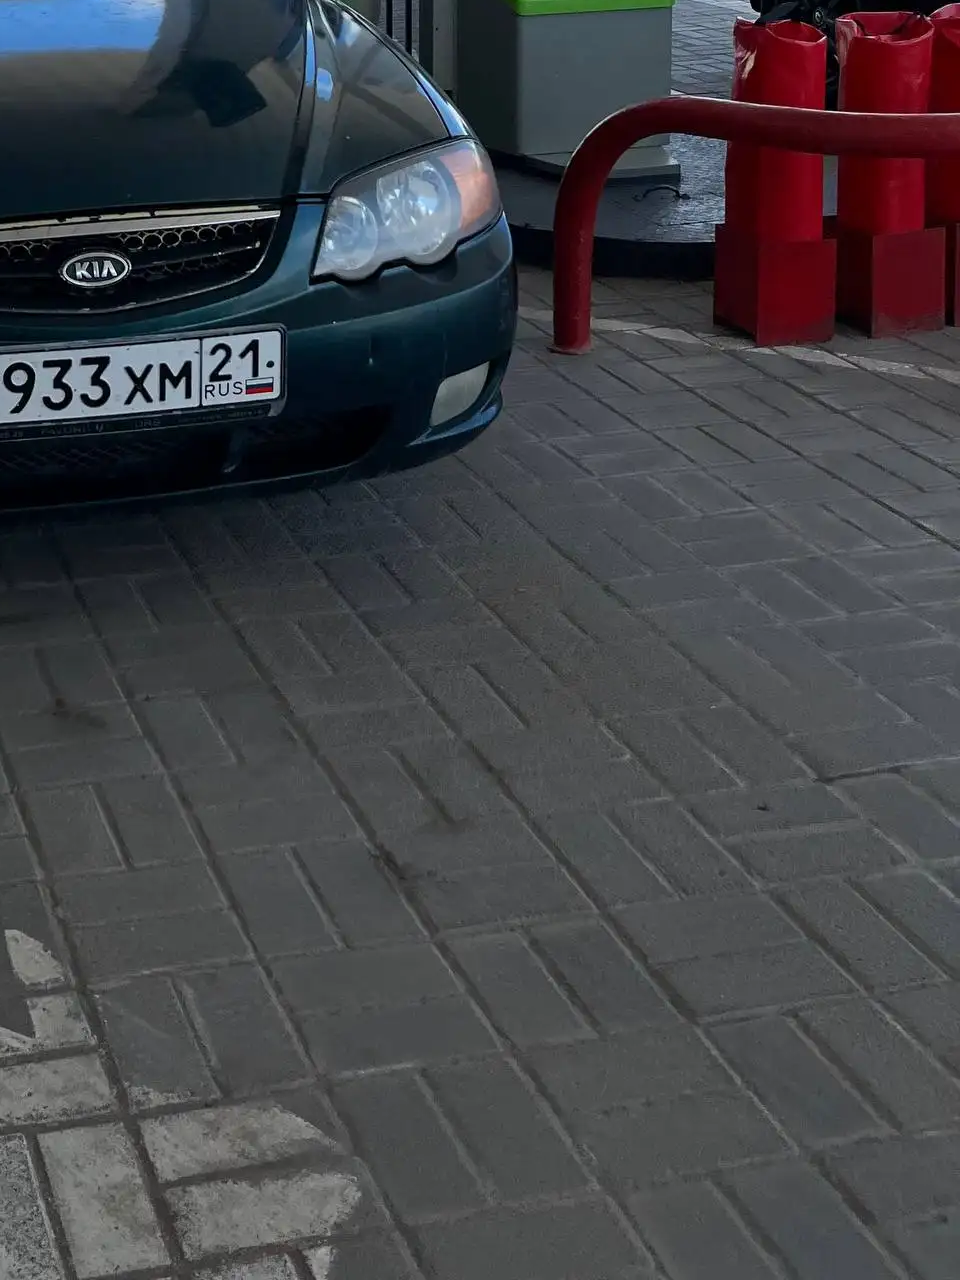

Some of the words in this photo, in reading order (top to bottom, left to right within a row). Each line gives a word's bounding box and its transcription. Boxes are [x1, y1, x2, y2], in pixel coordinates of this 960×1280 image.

[74, 260, 118, 280] KIA
[208, 338, 260, 383] 21
[203, 380, 244, 401] RUS
